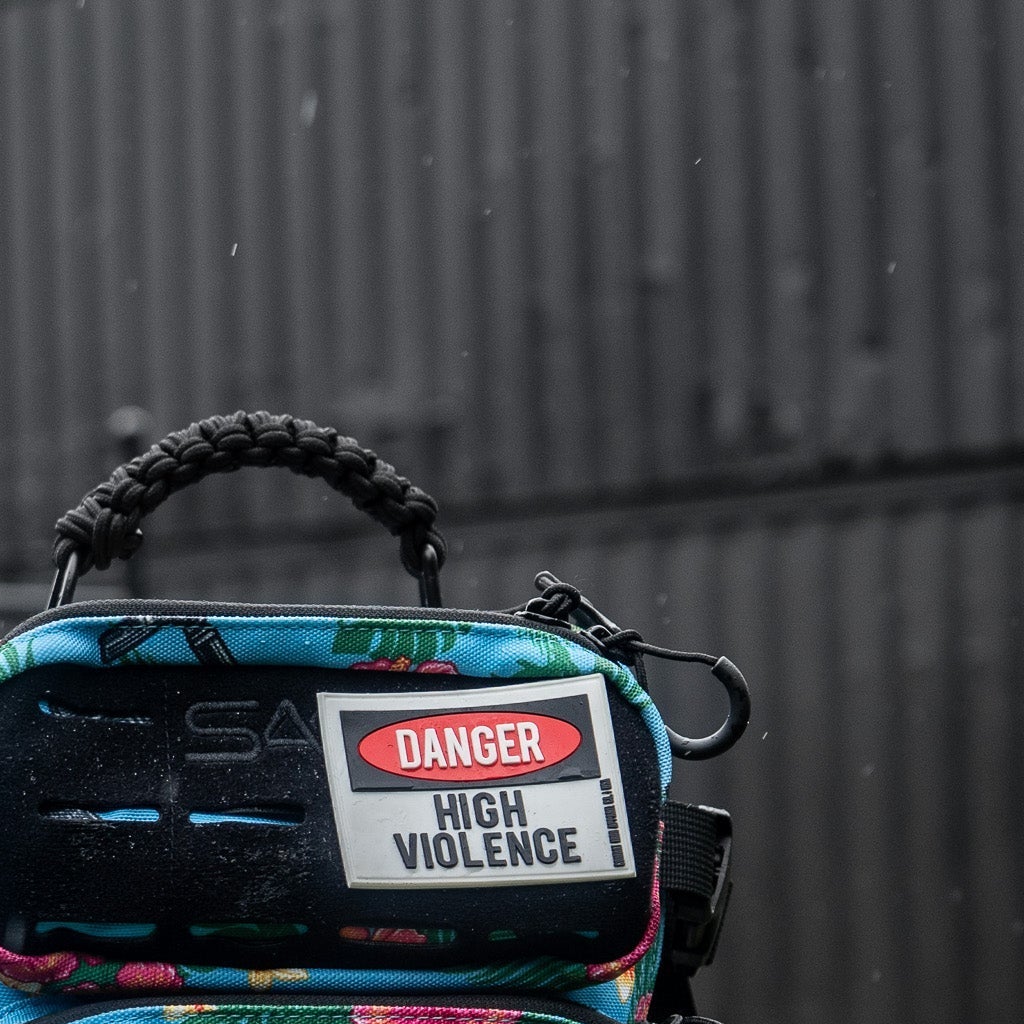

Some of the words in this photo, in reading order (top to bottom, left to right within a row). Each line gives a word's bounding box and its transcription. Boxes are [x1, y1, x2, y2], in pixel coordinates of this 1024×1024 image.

[184, 699, 323, 763] SA
[395, 721, 545, 770] DANGER
[433, 789, 528, 830] HIGH
[393, 827, 582, 869] VIOLENCE
